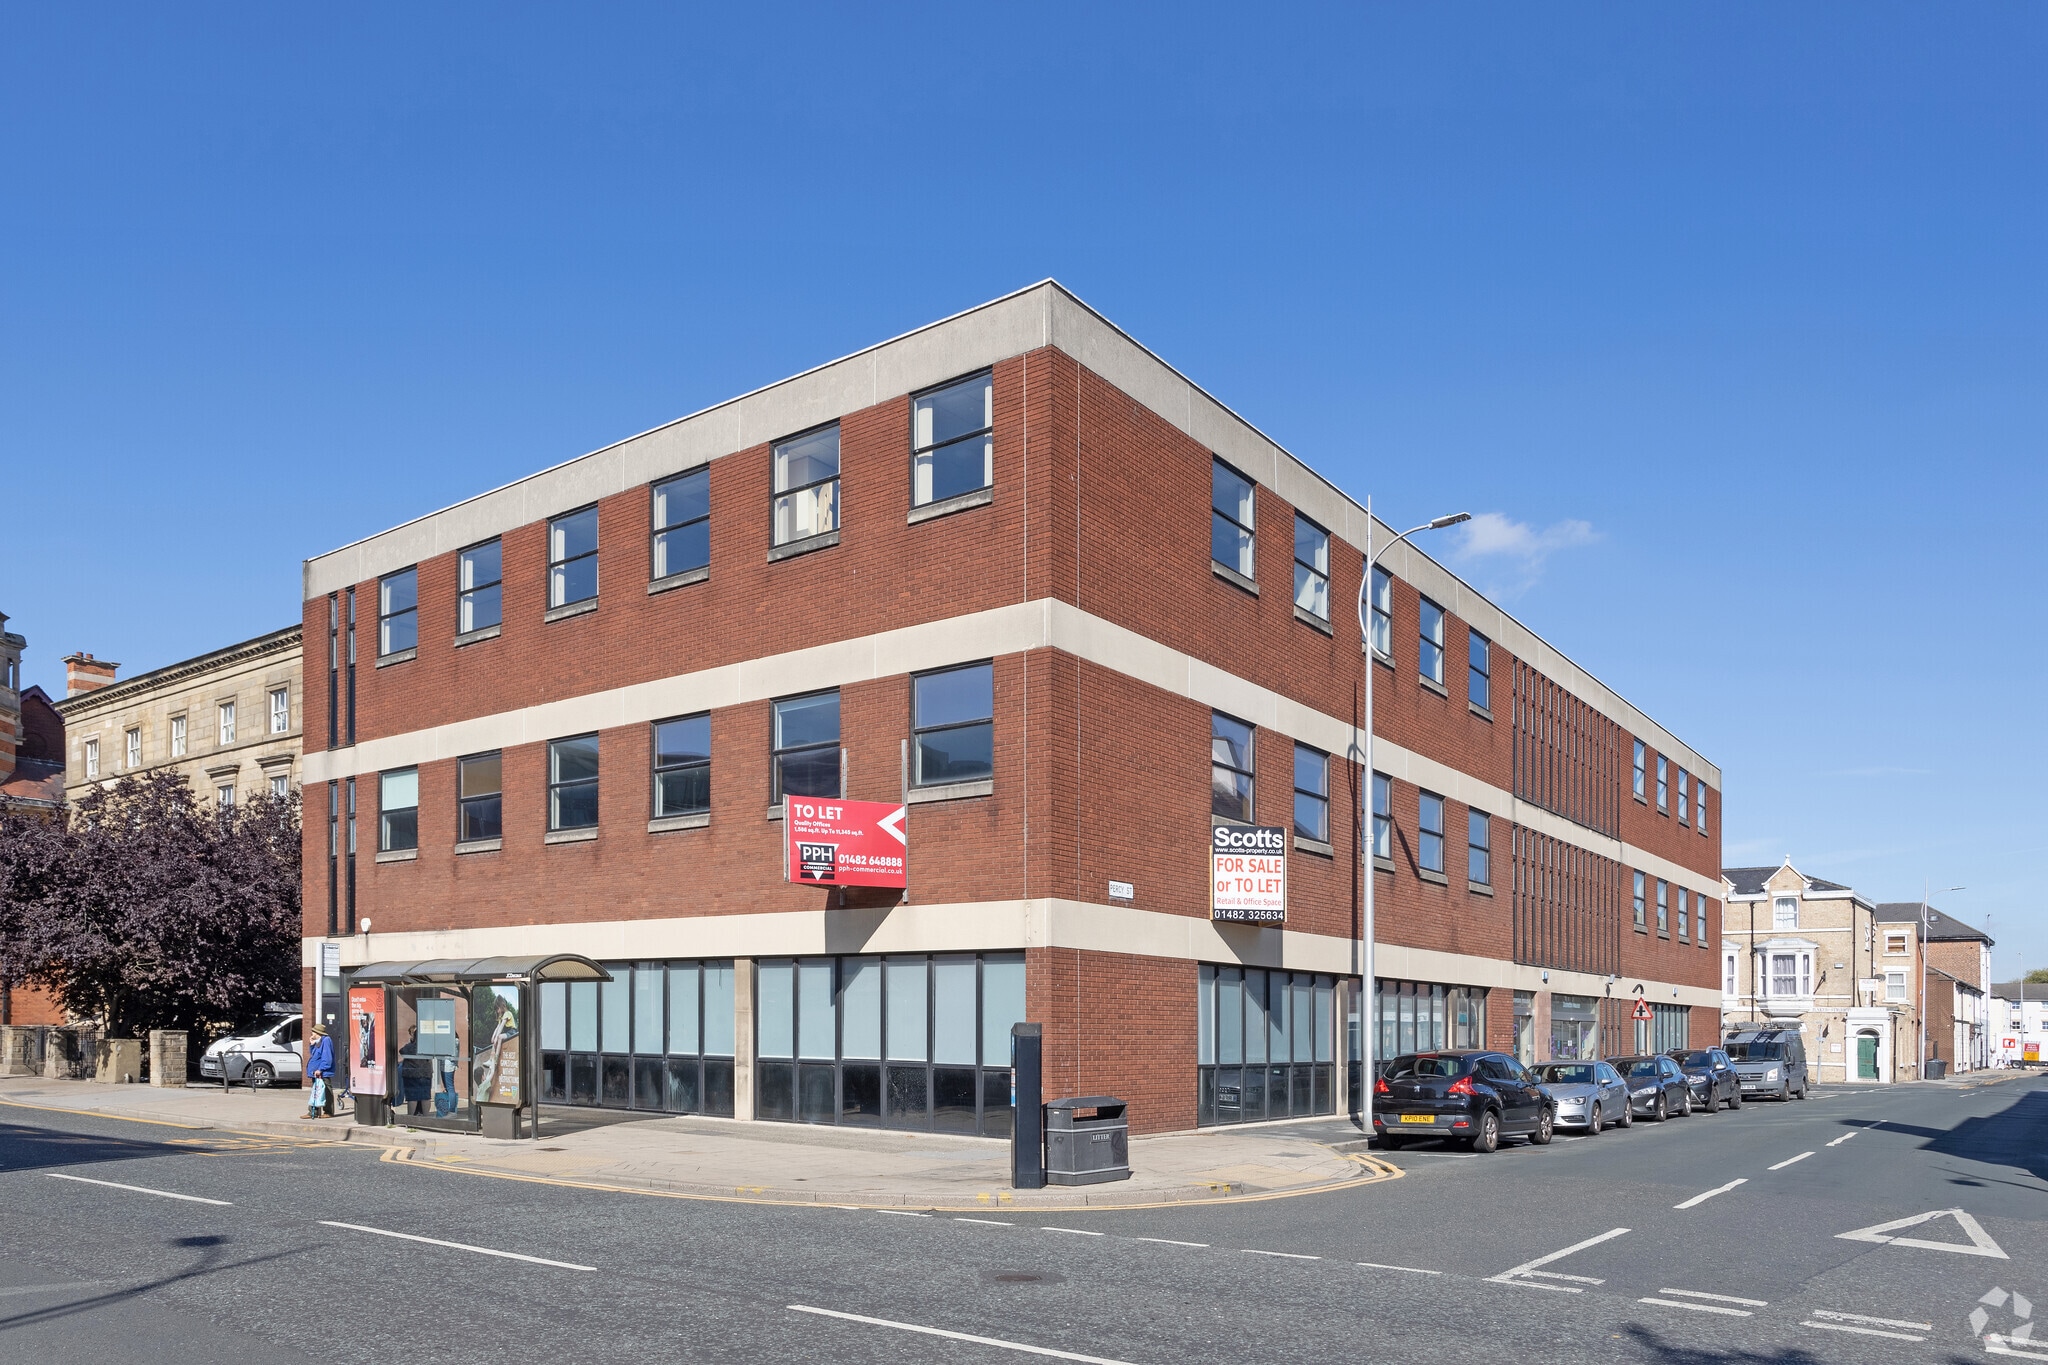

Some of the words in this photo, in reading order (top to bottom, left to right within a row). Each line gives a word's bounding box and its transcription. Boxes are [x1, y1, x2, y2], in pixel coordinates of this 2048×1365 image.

[794, 804, 814, 818] TO
[819, 806, 843, 820] LET
[1214, 827, 1283, 848] Scotts
[803, 846, 832, 861] PPH
[1215, 847, 1283, 855] www.scotts-property.co.uk
[839, 854, 866, 865] 01482
[869, 856, 902, 867] 648888
[1217, 858, 1244, 872] FOR
[1249, 859, 1281, 873] SALE
[839, 866, 902, 875] pph-commercial.co.uk
[1217, 881, 1231, 892] or
[1235, 878, 1253, 892] TO
[1258, 879, 1281, 893] LET
[1214, 910, 1244, 919] 01482
[1248, 911, 1283, 920] 325634
